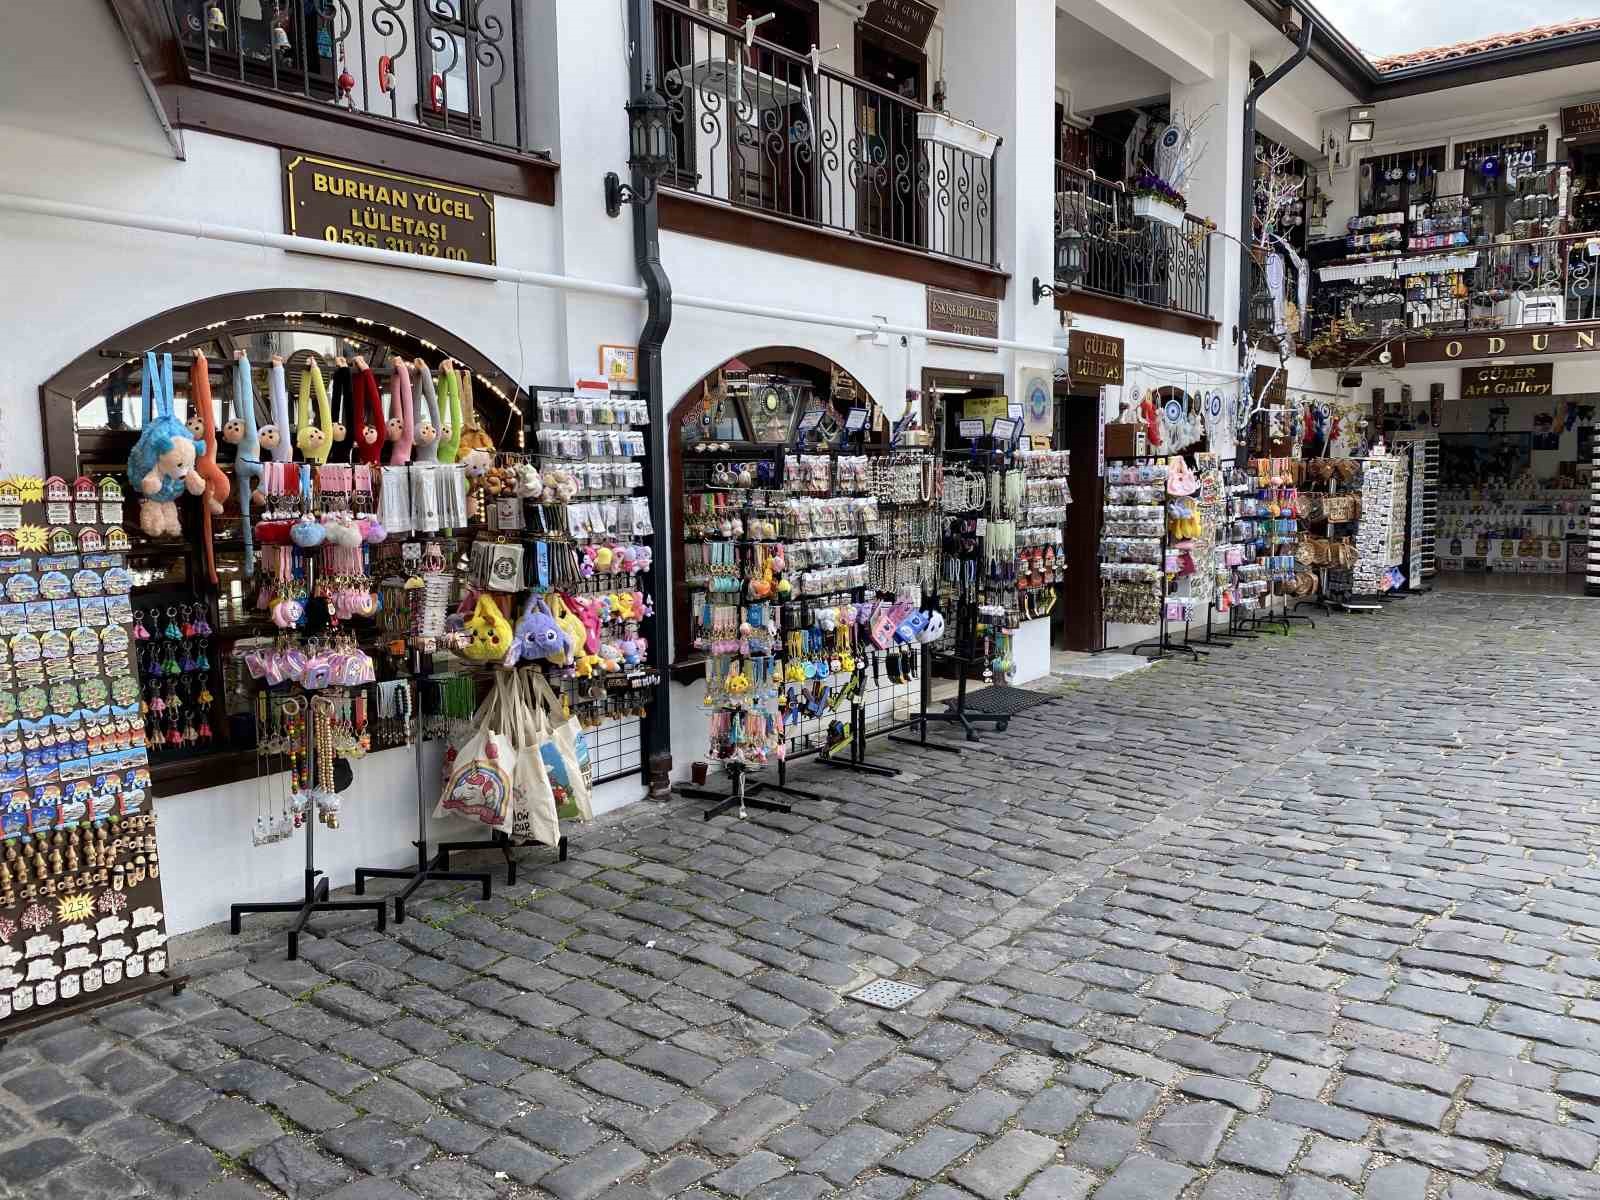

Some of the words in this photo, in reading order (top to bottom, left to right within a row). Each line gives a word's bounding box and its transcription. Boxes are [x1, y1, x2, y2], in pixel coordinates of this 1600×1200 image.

[313, 172, 408, 208] BURHAN
[412, 192, 474, 221] YÜCEL
[351, 207, 447, 241] LÜLETAŞI
[1084, 336, 1118, 358] GÜLER
[1478, 367, 1536, 381] GÜLER
[1464, 384, 1489, 396] Art
[1494, 381, 1551, 395] Gallery
